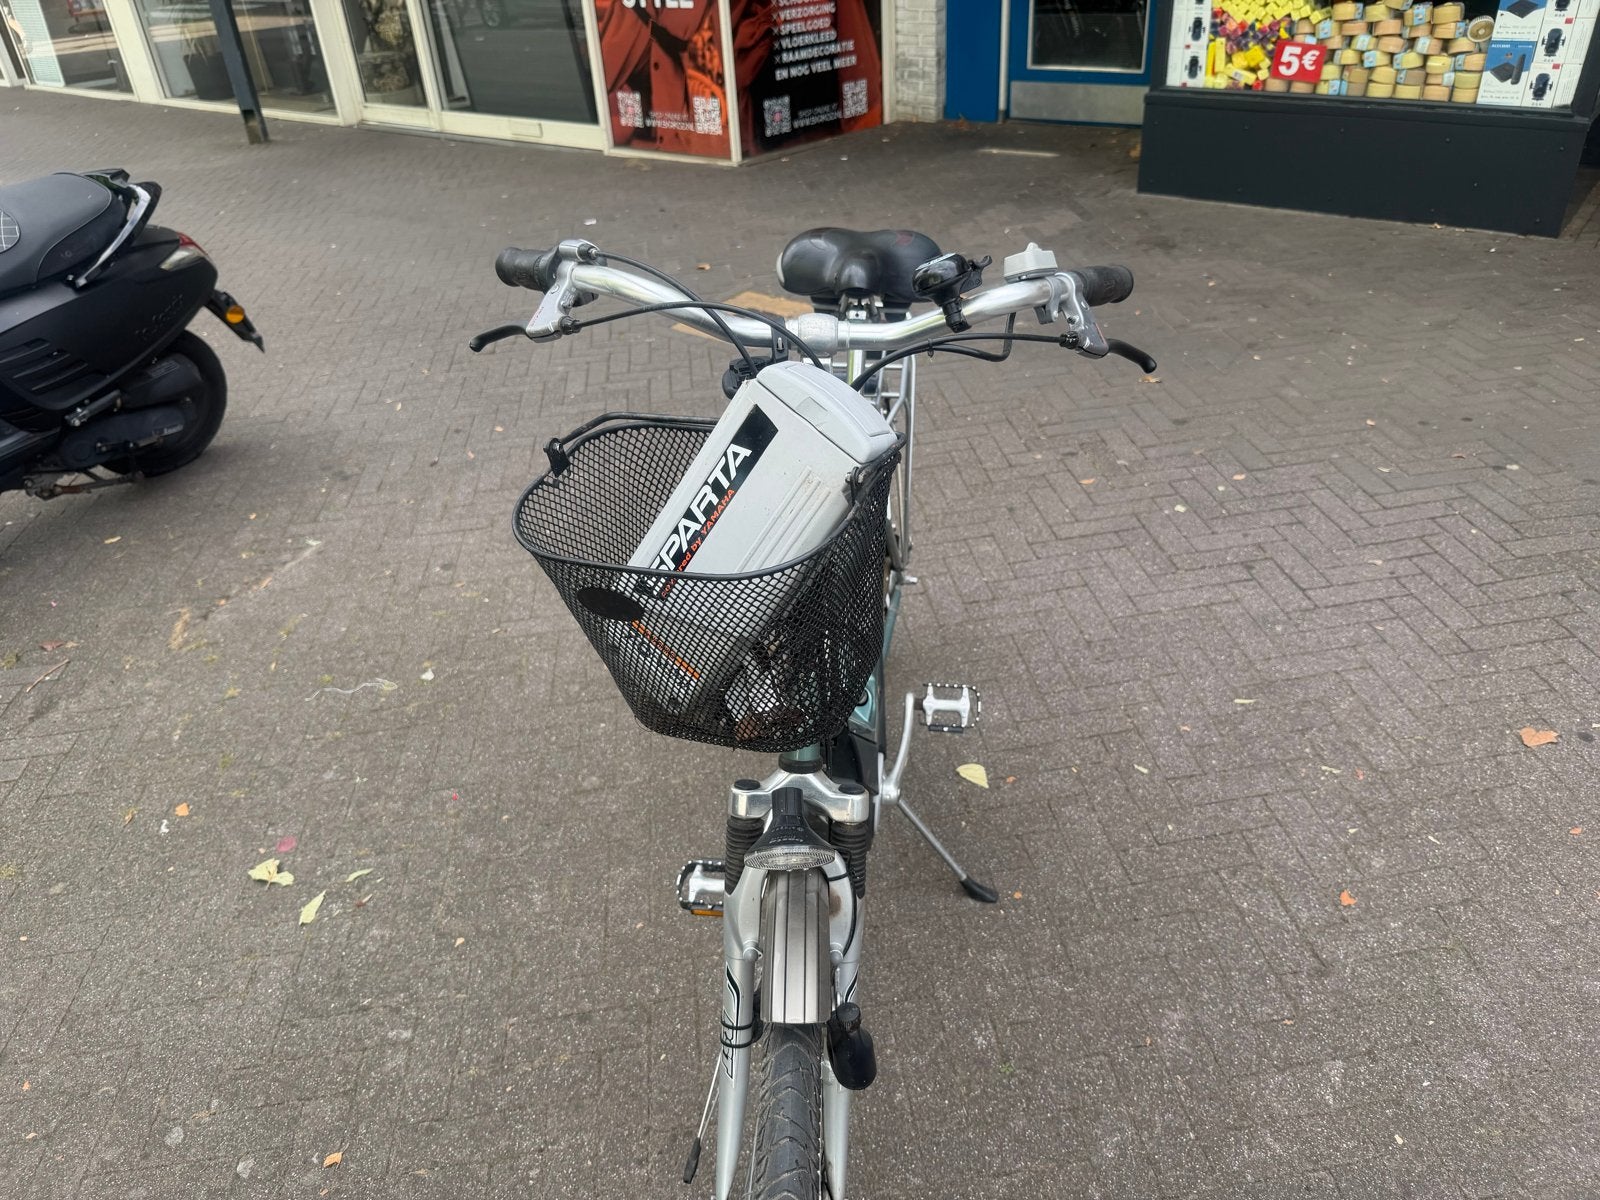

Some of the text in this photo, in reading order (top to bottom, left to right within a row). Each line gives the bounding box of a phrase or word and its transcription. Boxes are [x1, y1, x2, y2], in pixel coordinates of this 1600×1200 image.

[779, 2, 836, 20] VERZORGING
[780, 17, 832, 35] SPEELGOED
[780, 29, 837, 49] VLOERKLEED
[781, 40, 855, 63] RAAMDECORATIE
[1278, 45, 1320, 76] 5€
[775, 55, 857, 81] EN NOG VEEL MEER
[691, 538, 702, 553] by
[700, 488, 735, 536] YAMAHA
